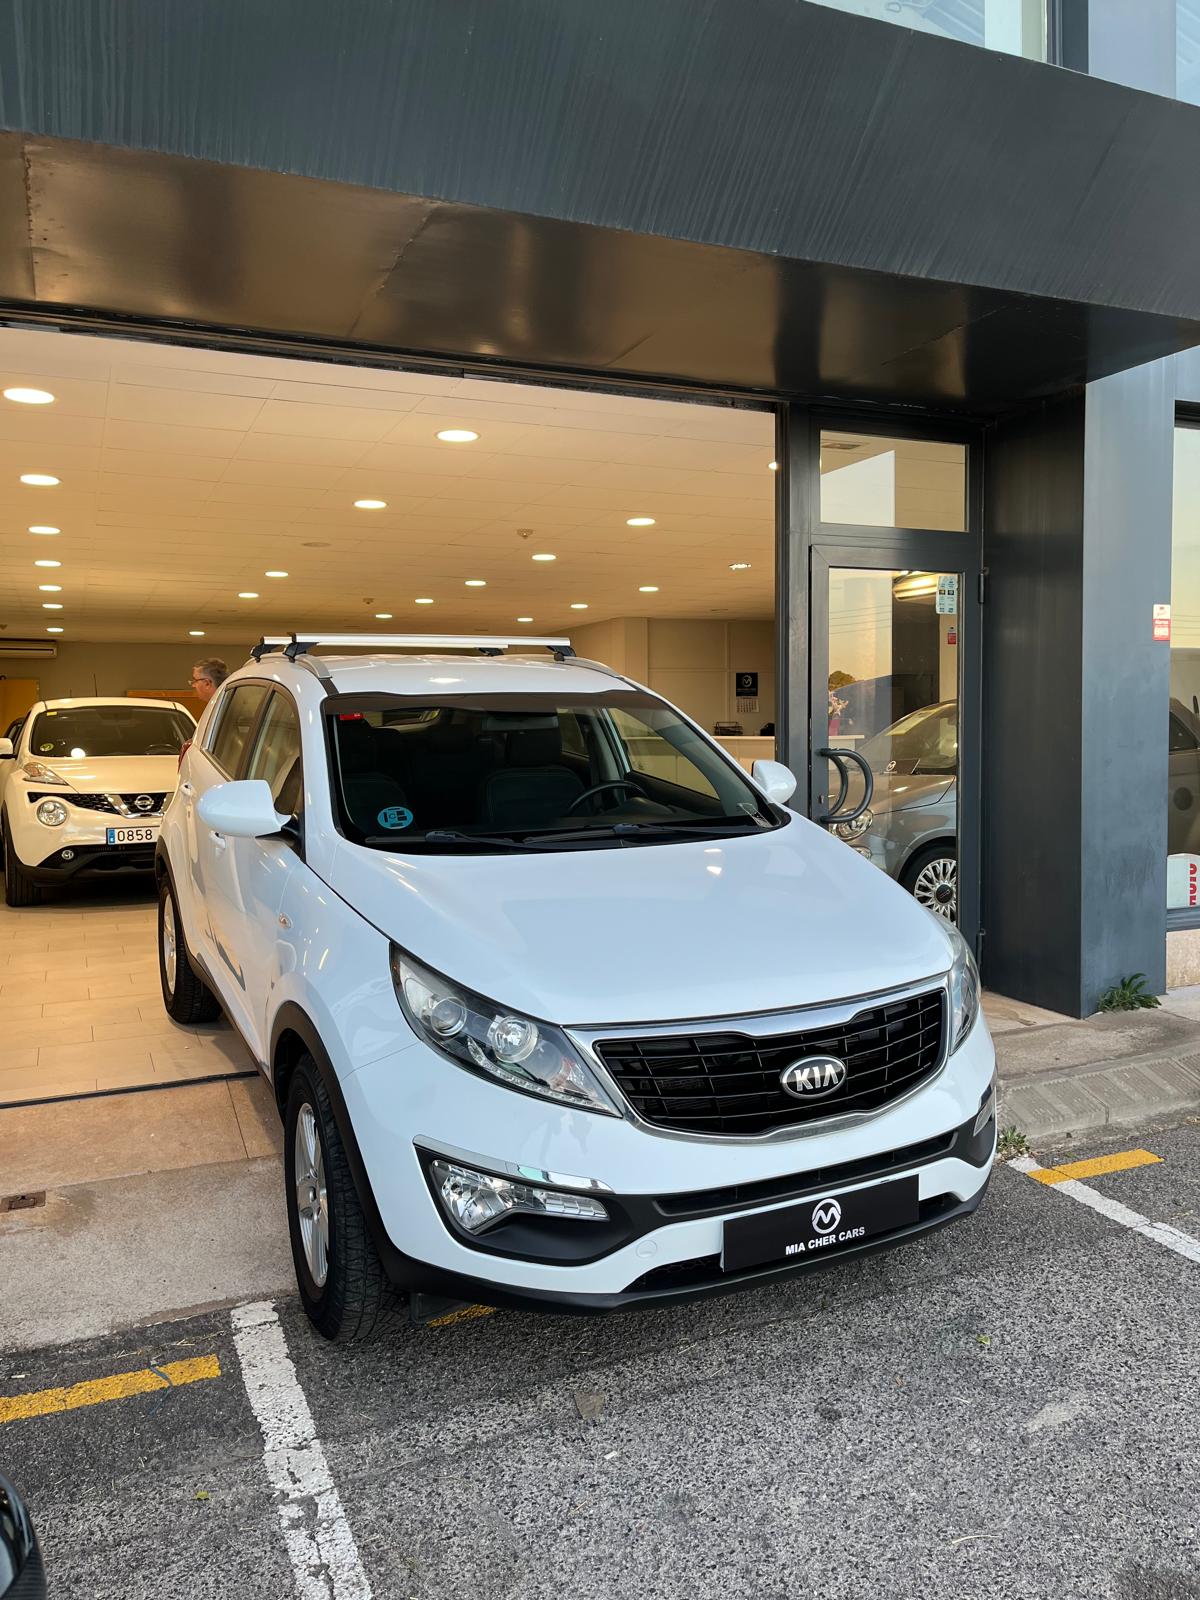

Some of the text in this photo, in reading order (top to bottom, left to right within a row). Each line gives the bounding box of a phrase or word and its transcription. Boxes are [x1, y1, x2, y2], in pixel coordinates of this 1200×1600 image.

[117, 829, 153, 842] 0858
[793, 1063, 839, 1092] KIA
[785, 1226, 865, 1256] MIA CHER CARS
